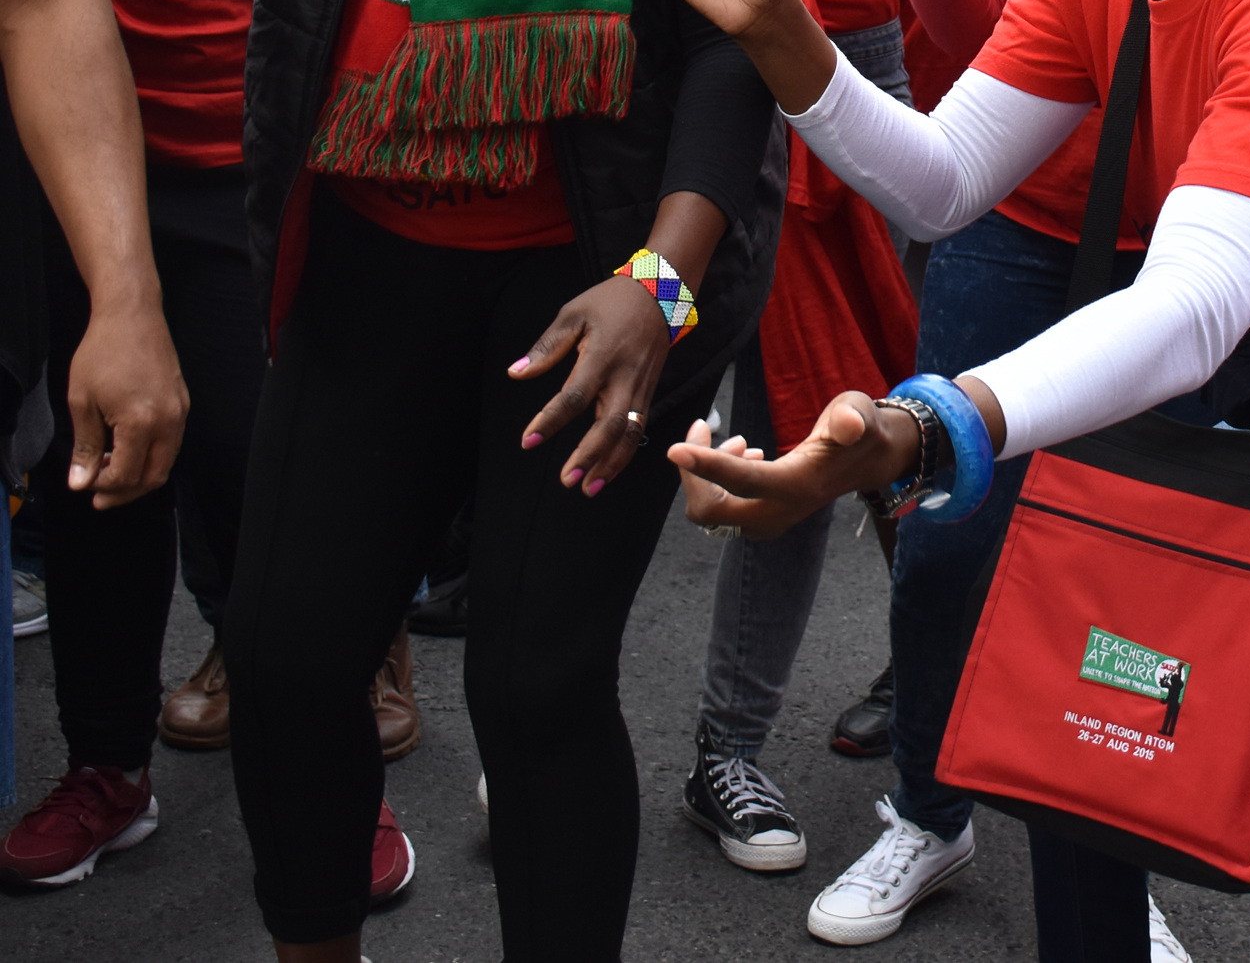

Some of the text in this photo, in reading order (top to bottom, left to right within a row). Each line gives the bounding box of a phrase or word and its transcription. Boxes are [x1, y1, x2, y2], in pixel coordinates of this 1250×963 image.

[1085, 648, 1156, 681] AT WORK
[1092, 632, 1157, 668] TEACHERS
[1082, 666, 1103, 679] UNITE
[1104, 670, 1113, 681] TO
[1064, 711, 1102, 731] INLAND
[1104, 722, 1142, 743] REGION
[1077, 729, 1155, 761] 26-27 AUG 2015
